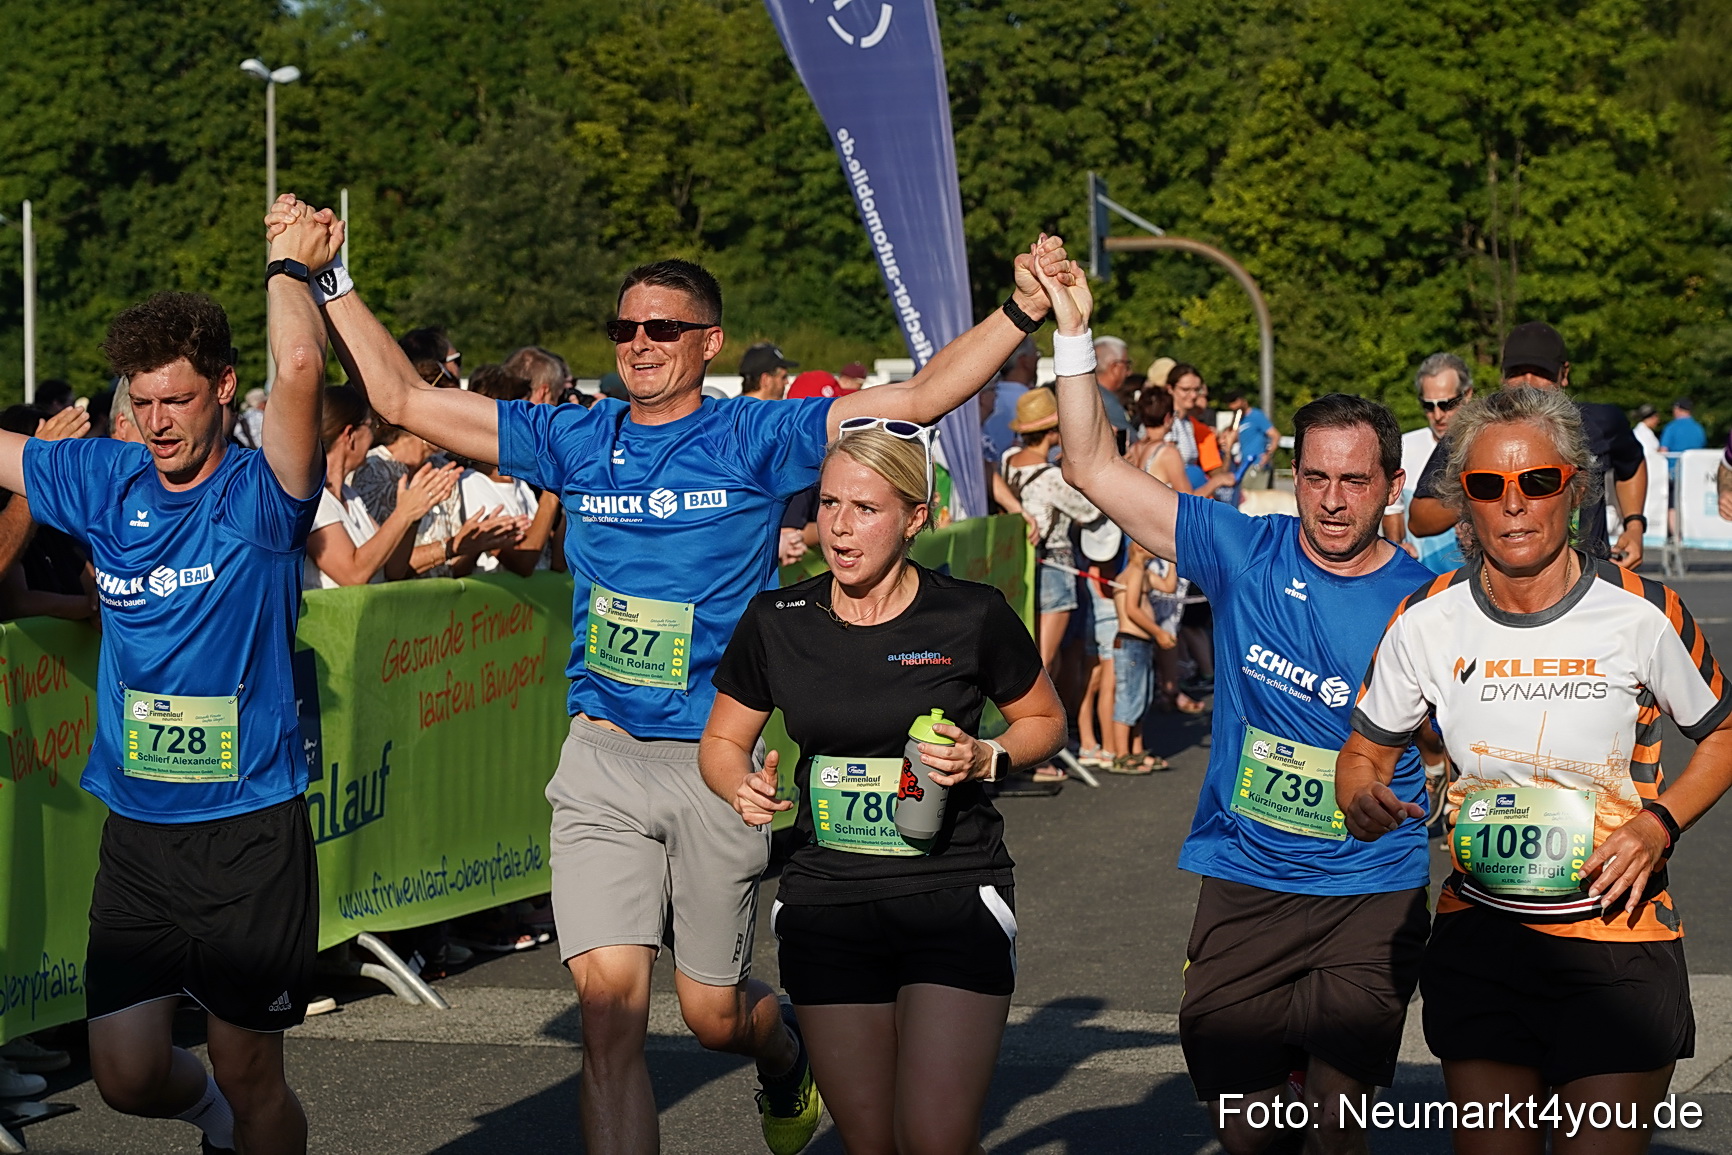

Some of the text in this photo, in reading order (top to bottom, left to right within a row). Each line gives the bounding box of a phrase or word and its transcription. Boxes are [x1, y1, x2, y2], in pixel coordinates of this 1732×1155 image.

[579, 494, 644, 514] SCHICK
[689, 492, 723, 507] BAU
[129, 520, 150, 528] erima
[184, 567, 210, 584] BAU
[123, 598, 146, 607] bauen
[786, 600, 806, 608] JAKO
[1284, 587, 1308, 602] erima
[607, 607, 640, 619] Firmenlauf
[382, 603, 534, 683] Gesunde Firmen
[589, 623, 598, 654] RUN
[606, 621, 661, 657] 727
[600, 649, 666, 672] Braun Roland
[671, 637, 685, 677] 2022
[887, 650, 941, 662] autoladen
[901, 656, 952, 666] neumarkt
[1245, 644, 1318, 692] SCHICK
[1485, 658, 1607, 678] KLEBL
[0, 654, 69, 708] irmen
[419, 637, 548, 730] laufen länger!
[1241, 666, 1312, 703] einfach schick bauen
[1480, 681, 1609, 701] DYNAMICS
[149, 710, 184, 718] Firmenlauf
[8, 695, 93, 788] länger!
[129, 730, 139, 760] RUN
[148, 723, 207, 755] 728
[221, 731, 232, 770] 2022
[137, 751, 221, 765] Schlierf Alexander
[1269, 752, 1306, 767] Firmenlauf
[841, 775, 881, 783] Firmenlauf
[1239, 767, 1254, 799] RUN
[1264, 766, 1324, 807] 739
[818, 799, 831, 831] RUN
[1248, 790, 1293, 814] Kürzinger
[1294, 806, 1332, 823] Markus
[1489, 806, 1531, 816] Firmenlauf
[834, 823, 901, 837] Schmid Kat
[1331, 810, 1345, 830] 20
[1461, 836, 1472, 871] RUN
[1475, 824, 1568, 861] 1080
[1571, 834, 1586, 882] 2022
[338, 834, 544, 920] www.firmenlauf-oberpfalz.de
[1475, 862, 1566, 879] Mederer Birgit
